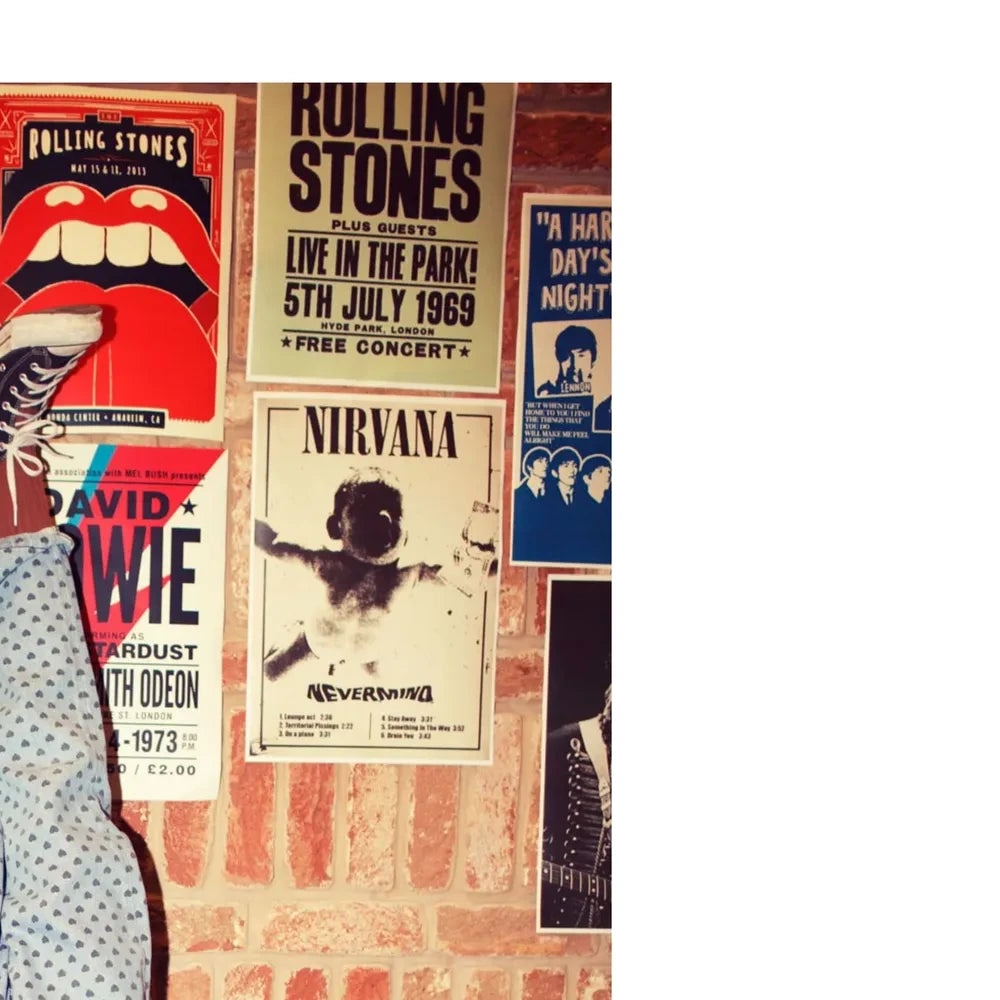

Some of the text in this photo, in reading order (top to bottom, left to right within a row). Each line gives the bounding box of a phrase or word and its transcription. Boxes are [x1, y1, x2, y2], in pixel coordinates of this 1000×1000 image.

[290, 83, 486, 146] ROLLING
[29, 128, 188, 168] ROLLING STONES
[71, 164, 87, 173] MAY
[288, 140, 482, 223] STONES
[331, 220, 437, 236] PLUS GUESTS
[571, 210, 612, 241] HAR
[286, 236, 478, 285] LIVE IN THE PARK!
[551, 246, 612, 277] DAY'S
[283, 282, 476, 327] 5TH JULY 1969
[541, 283, 612, 312] NIGHT
[321, 322, 435, 336] HYDE PARK, LONDON
[295, 336, 457, 359] FREE CONCERT
[560, 381, 591, 393] LENNON
[73, 413, 100, 422] CENTER
[151, 415, 160, 424] CA
[302, 405, 459, 458] NIRVANA
[131, 632, 145, 640] AS
[94, 642, 198, 660] TARDUST
[140, 668, 199, 709] ODEON
[307, 683, 434, 704] NEVERMIND
[135, 711, 173, 720] LONDON
[148, 764, 196, 776] £2.00
